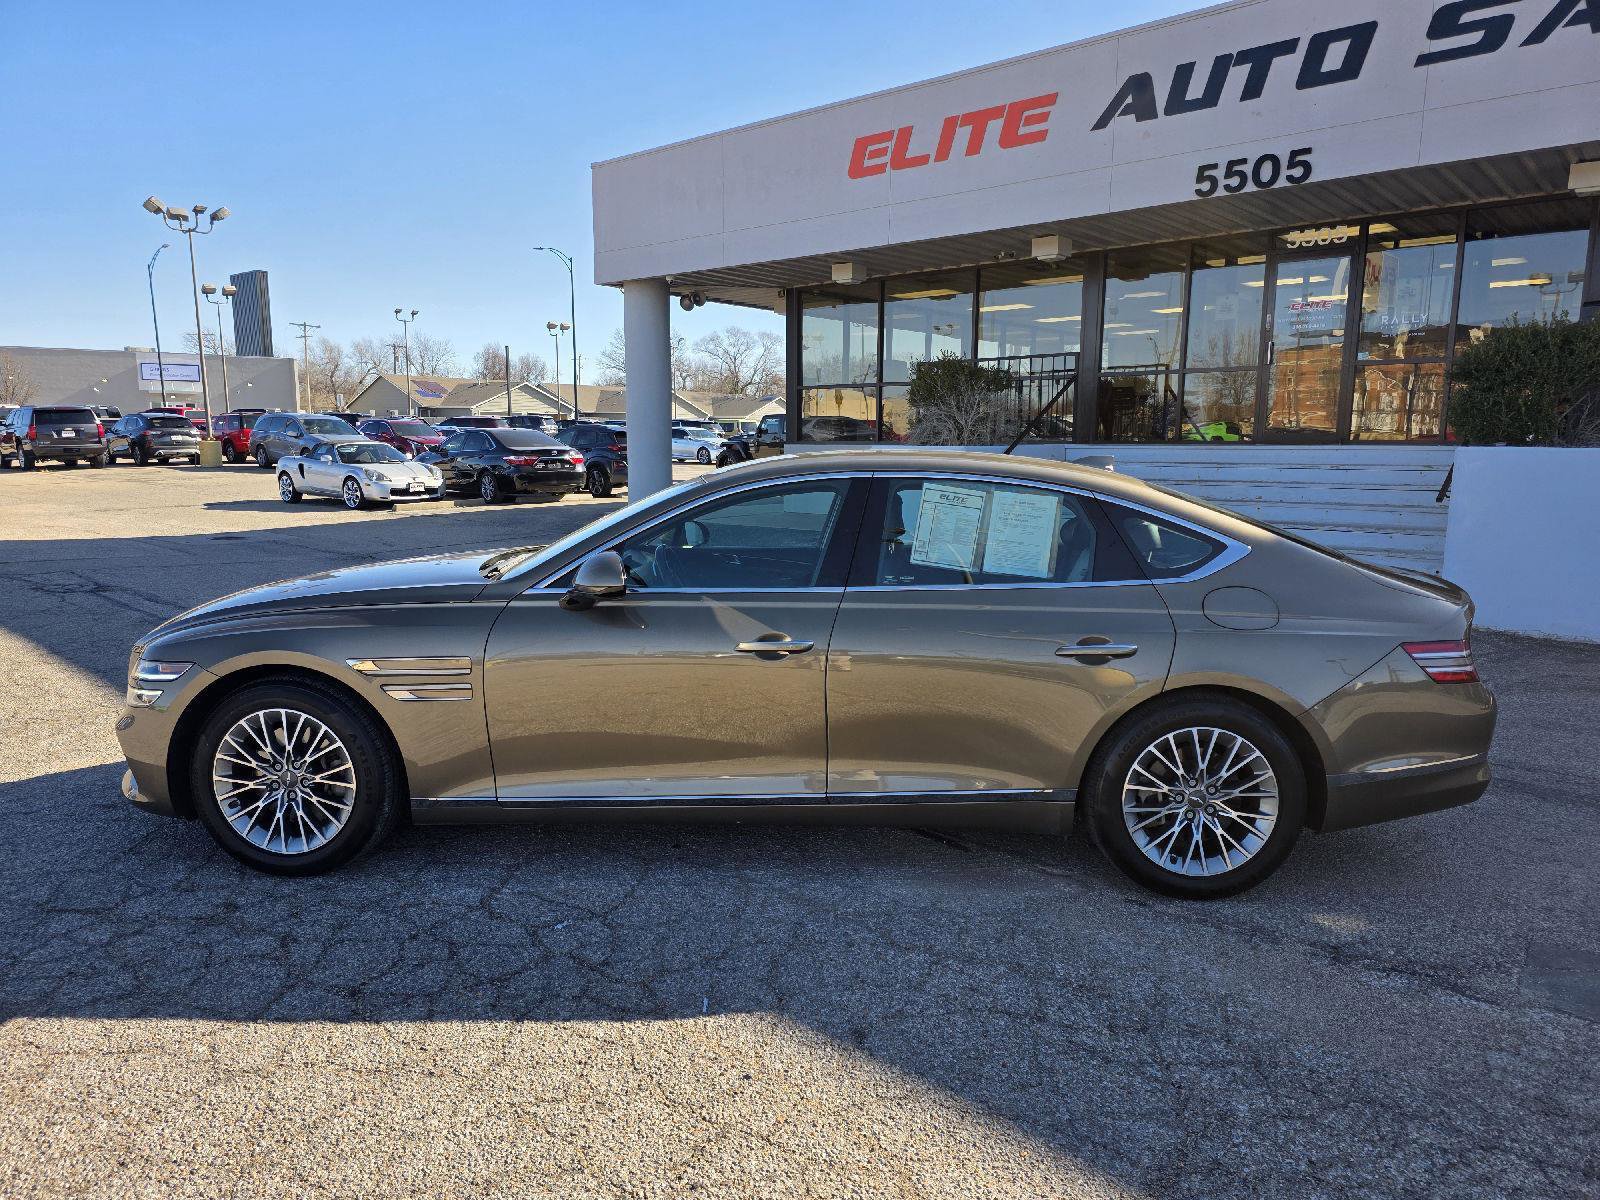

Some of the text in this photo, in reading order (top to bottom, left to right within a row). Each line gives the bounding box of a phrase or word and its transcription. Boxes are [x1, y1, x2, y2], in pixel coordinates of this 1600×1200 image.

[848, 92, 1059, 179] ELITE
[1090, 20, 1378, 131] AUTO
[1194, 147, 1313, 198] 5505
[1286, 225, 1348, 249] 5505
[1381, 313, 1429, 325] RALLY
